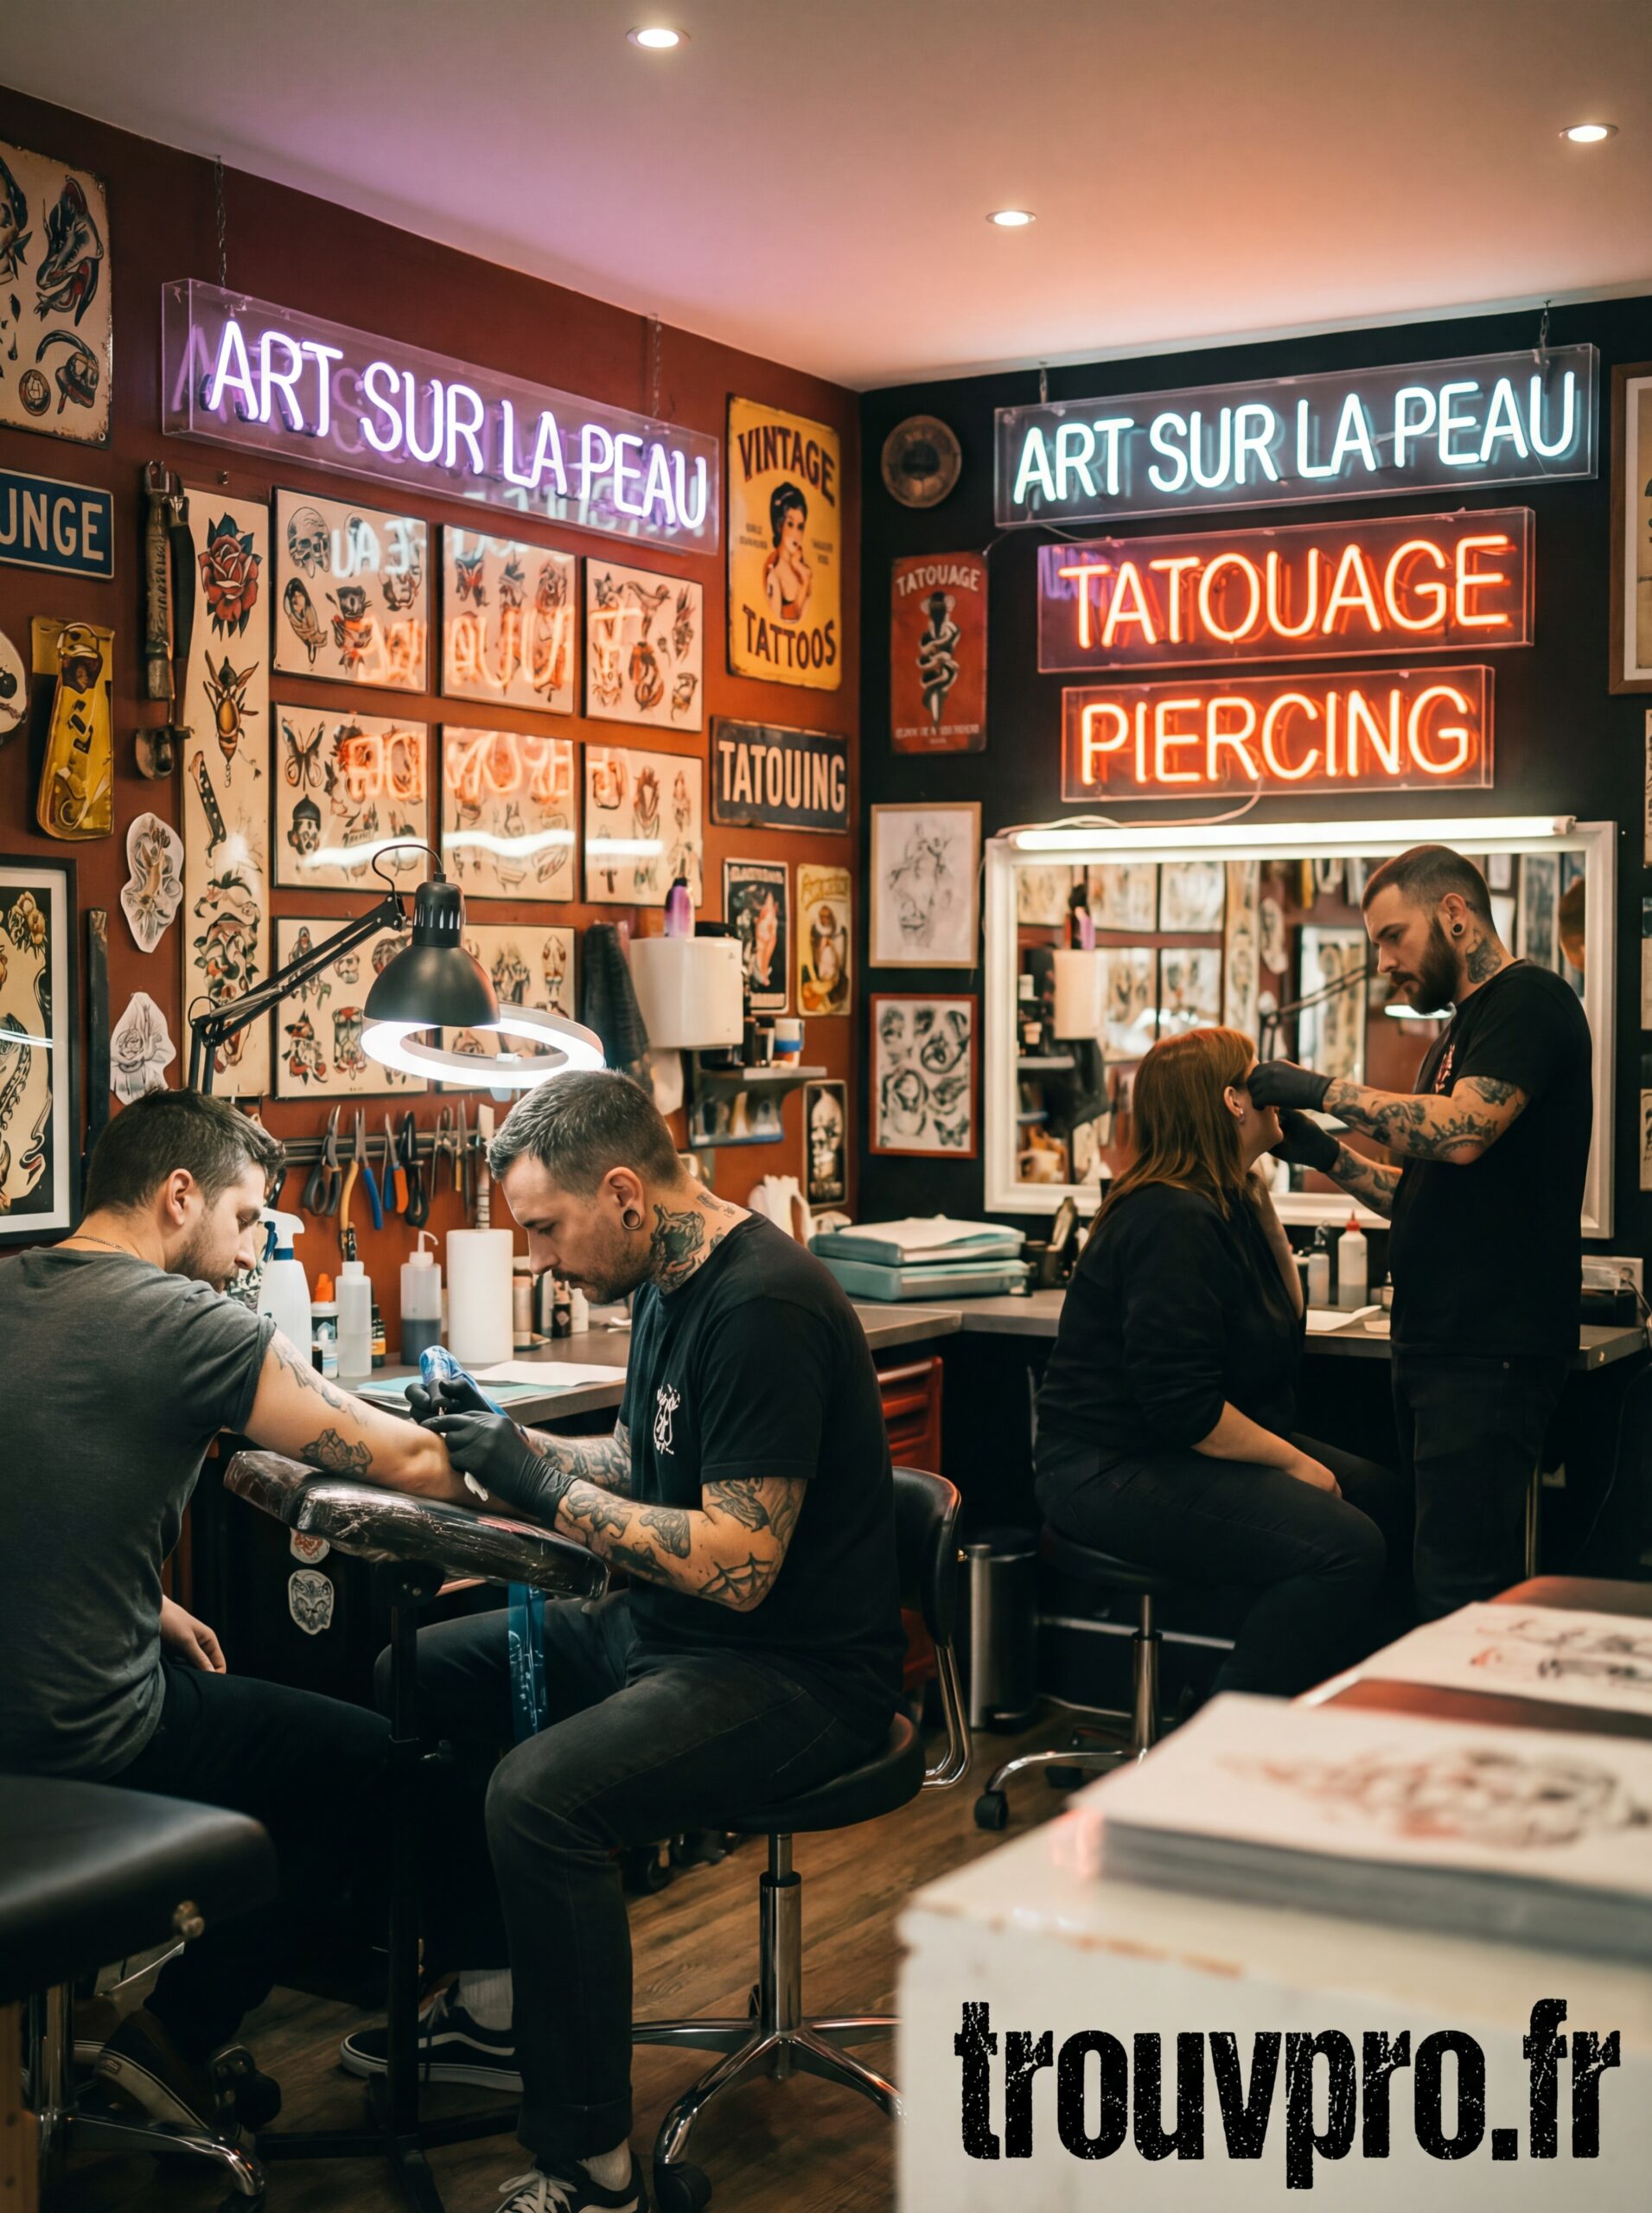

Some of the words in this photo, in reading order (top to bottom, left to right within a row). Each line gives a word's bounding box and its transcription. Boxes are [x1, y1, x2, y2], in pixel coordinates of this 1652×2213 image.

[207, 320, 344, 438] ART
[358, 360, 485, 476] SUR
[500, 399, 569, 496] LA
[579, 424, 708, 530] PEAU
[737, 425, 836, 507] VINTAGE
[1012, 418, 1134, 505] ART
[1147, 403, 1277, 493] SUR
[1296, 392, 1377, 478] LA
[1393, 371, 1576, 468] PEAU
[896, 564, 982, 597] TATOUAGE
[1058, 534, 1509, 649] TATOUAGE
[743, 603, 837, 671] TATTOOS
[718, 739, 846, 814] TATOUING
[1081, 686, 1470, 785] PIERCING
